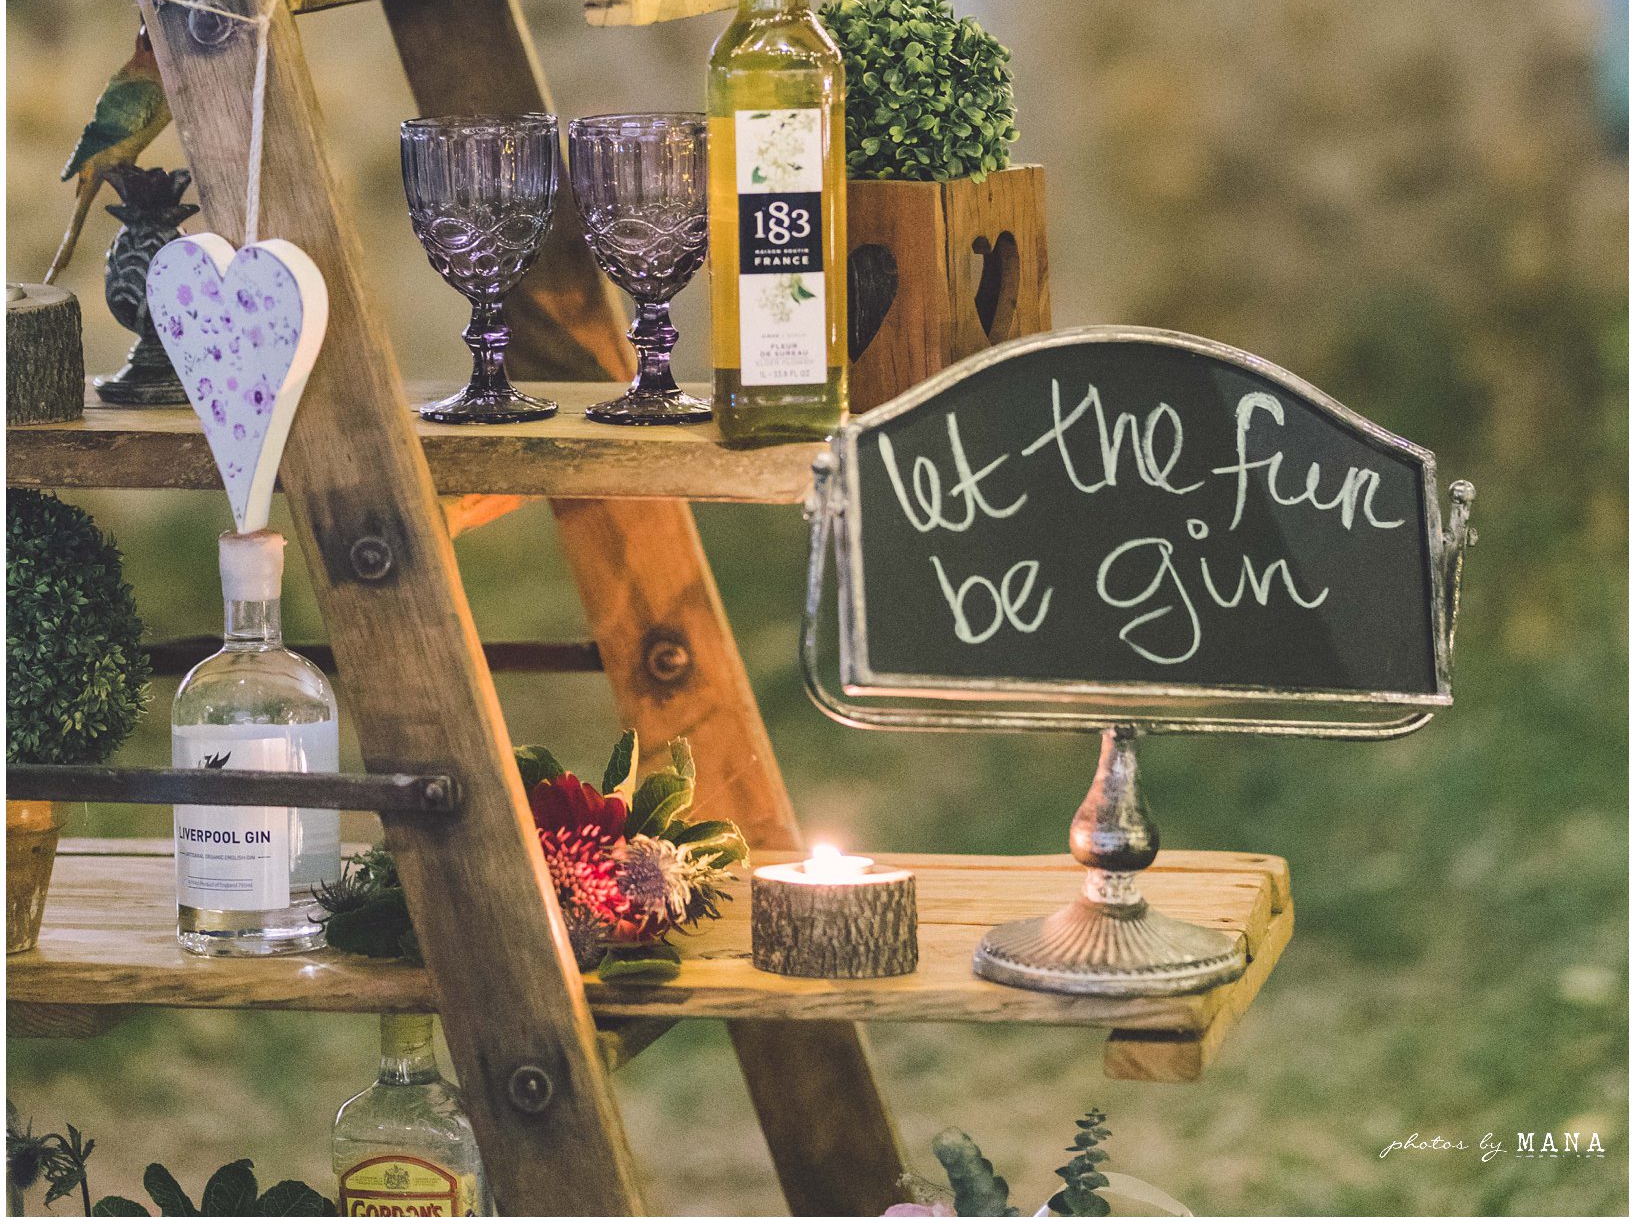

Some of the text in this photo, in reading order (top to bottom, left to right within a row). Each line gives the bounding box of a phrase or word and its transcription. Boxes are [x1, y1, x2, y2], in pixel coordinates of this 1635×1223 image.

[754, 255, 810, 266] FRANCE
[879, 377, 1405, 533] let the fun
[929, 517, 1330, 665] be gin
[179, 826, 271, 844] LIVERPOOL GIN
